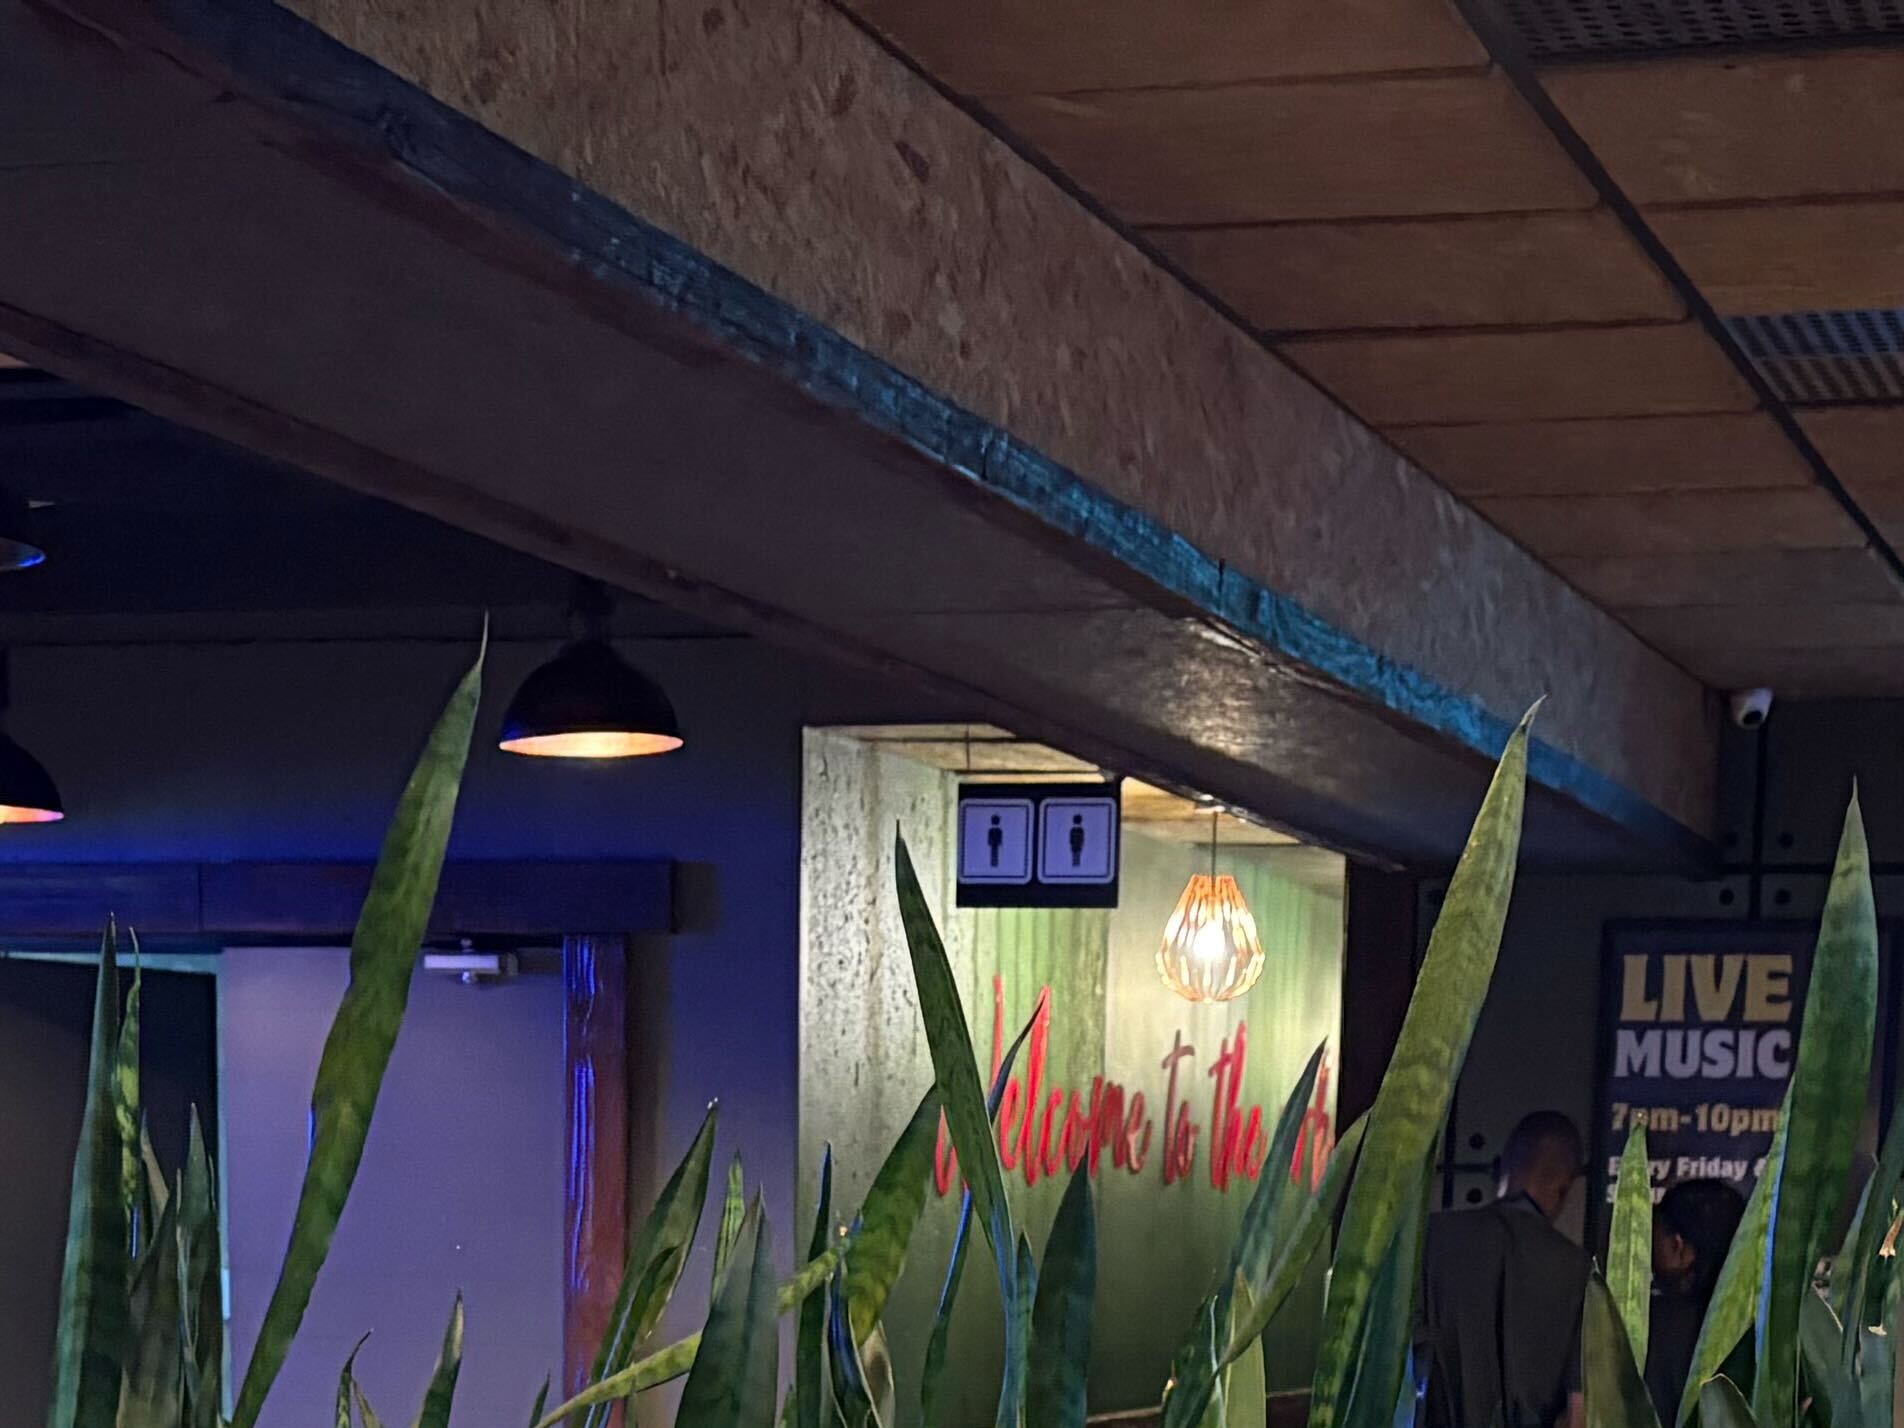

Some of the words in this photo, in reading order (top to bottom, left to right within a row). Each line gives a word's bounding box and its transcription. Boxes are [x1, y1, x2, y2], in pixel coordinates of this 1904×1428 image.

[1620, 954, 1793, 1022] LIVE
[1613, 1029, 1792, 1079] MUSIC
[1162, 1029, 1200, 1185] to
[1208, 1020, 1266, 1193] the
[1609, 1156, 1672, 1181] Ery
[1677, 1156, 1748, 1181] Friday
